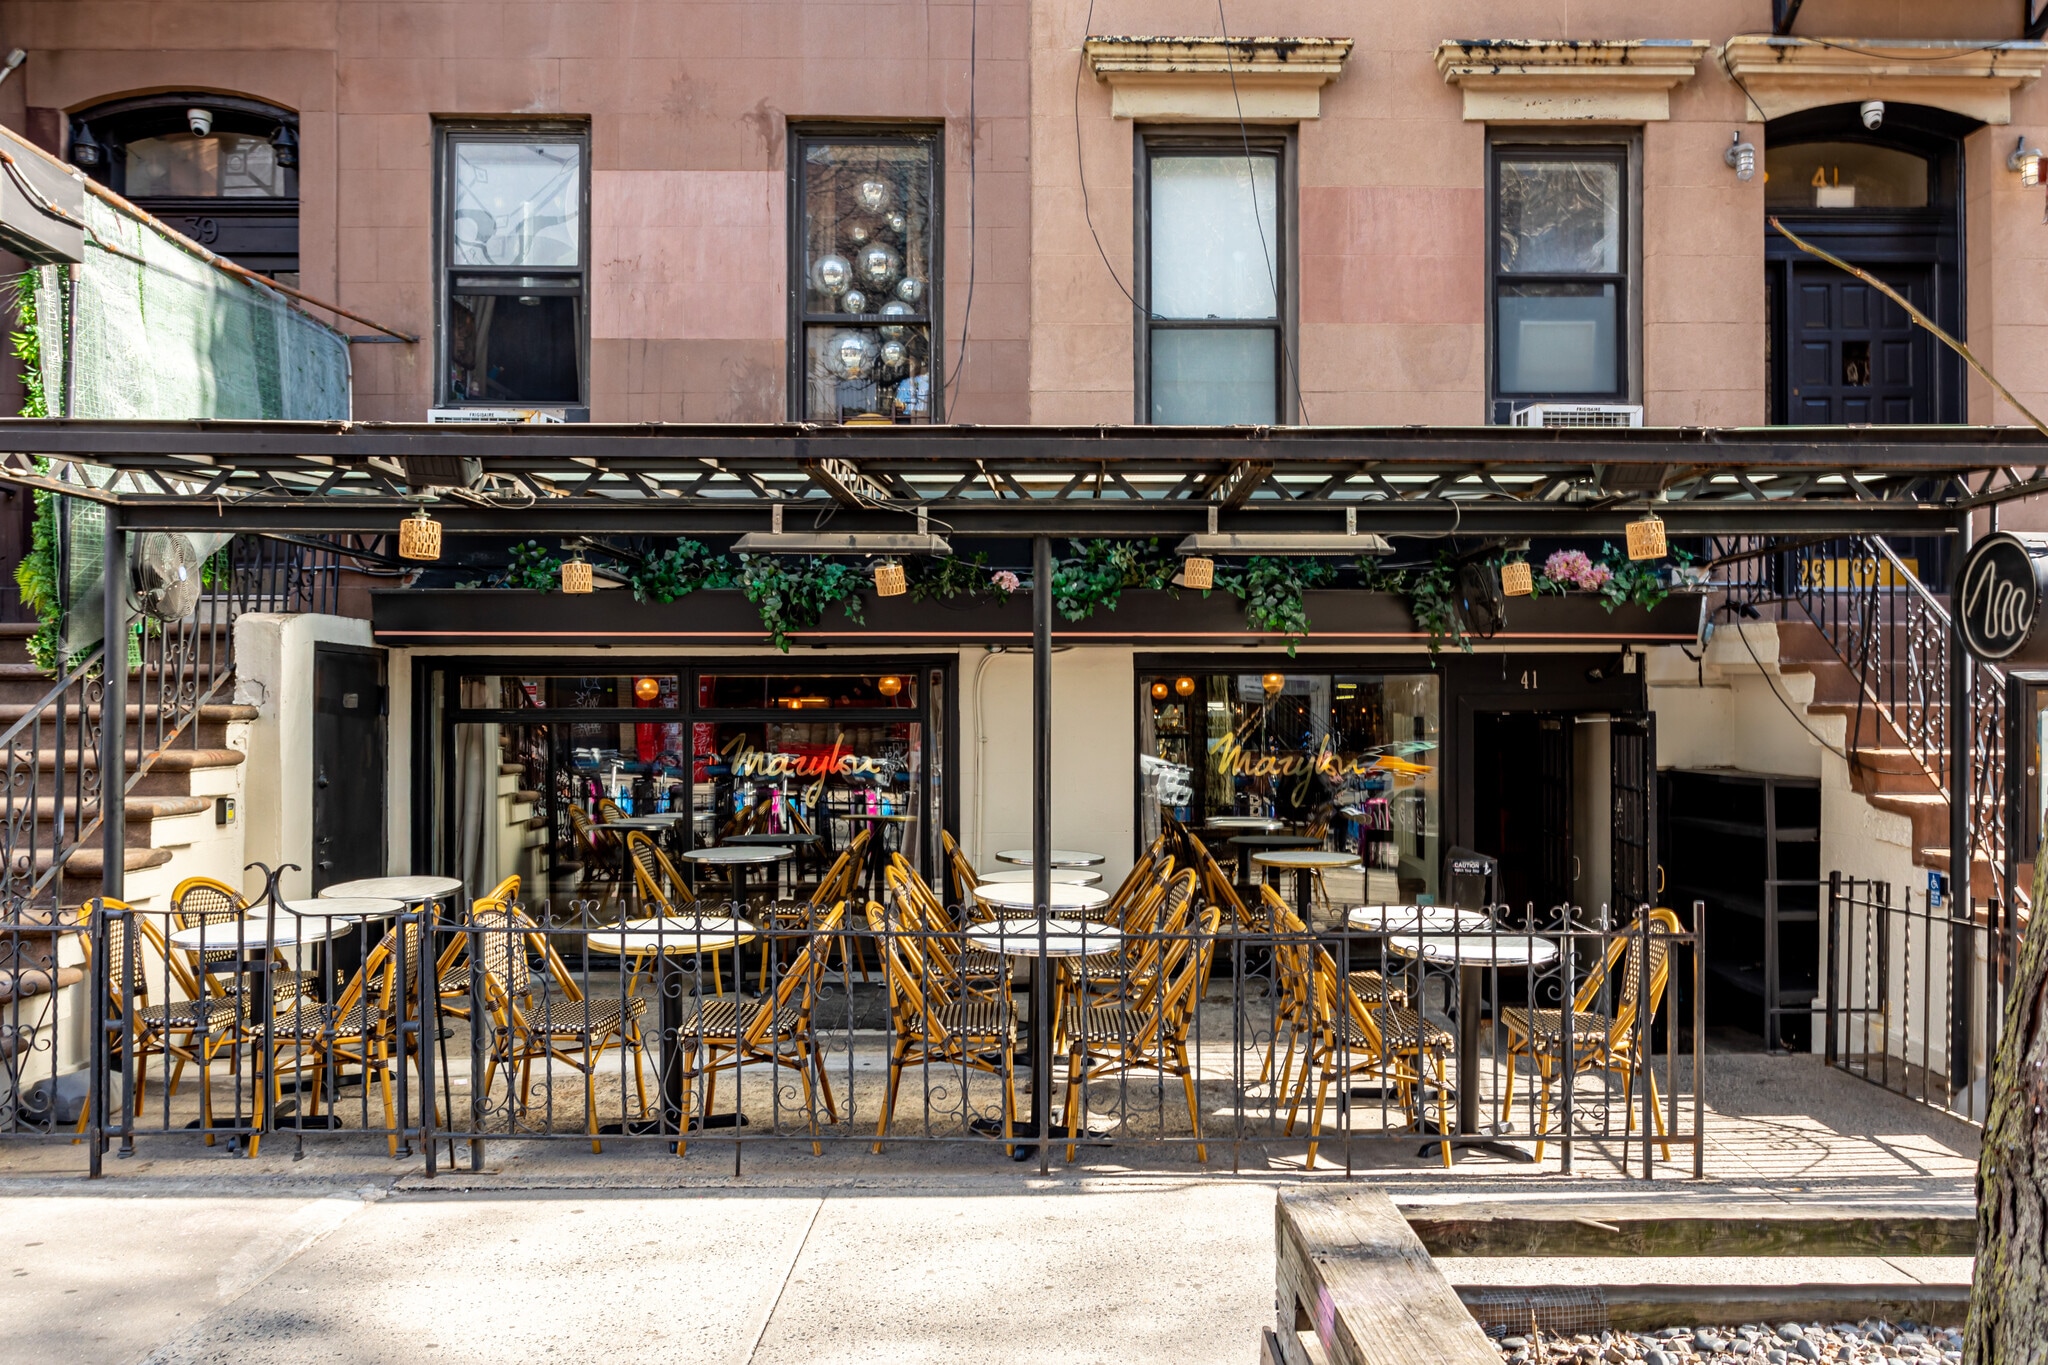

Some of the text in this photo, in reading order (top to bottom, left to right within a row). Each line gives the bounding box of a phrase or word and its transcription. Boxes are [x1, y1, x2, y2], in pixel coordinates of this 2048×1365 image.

[1811, 165, 1840, 188] 41
[184, 216, 219, 244] 39
[1520, 670, 1538, 690] 41
[721, 732, 881, 808] Marylou
[1208, 731, 1367, 809] Marylou
[1454, 861, 1480, 869] CAUTION
